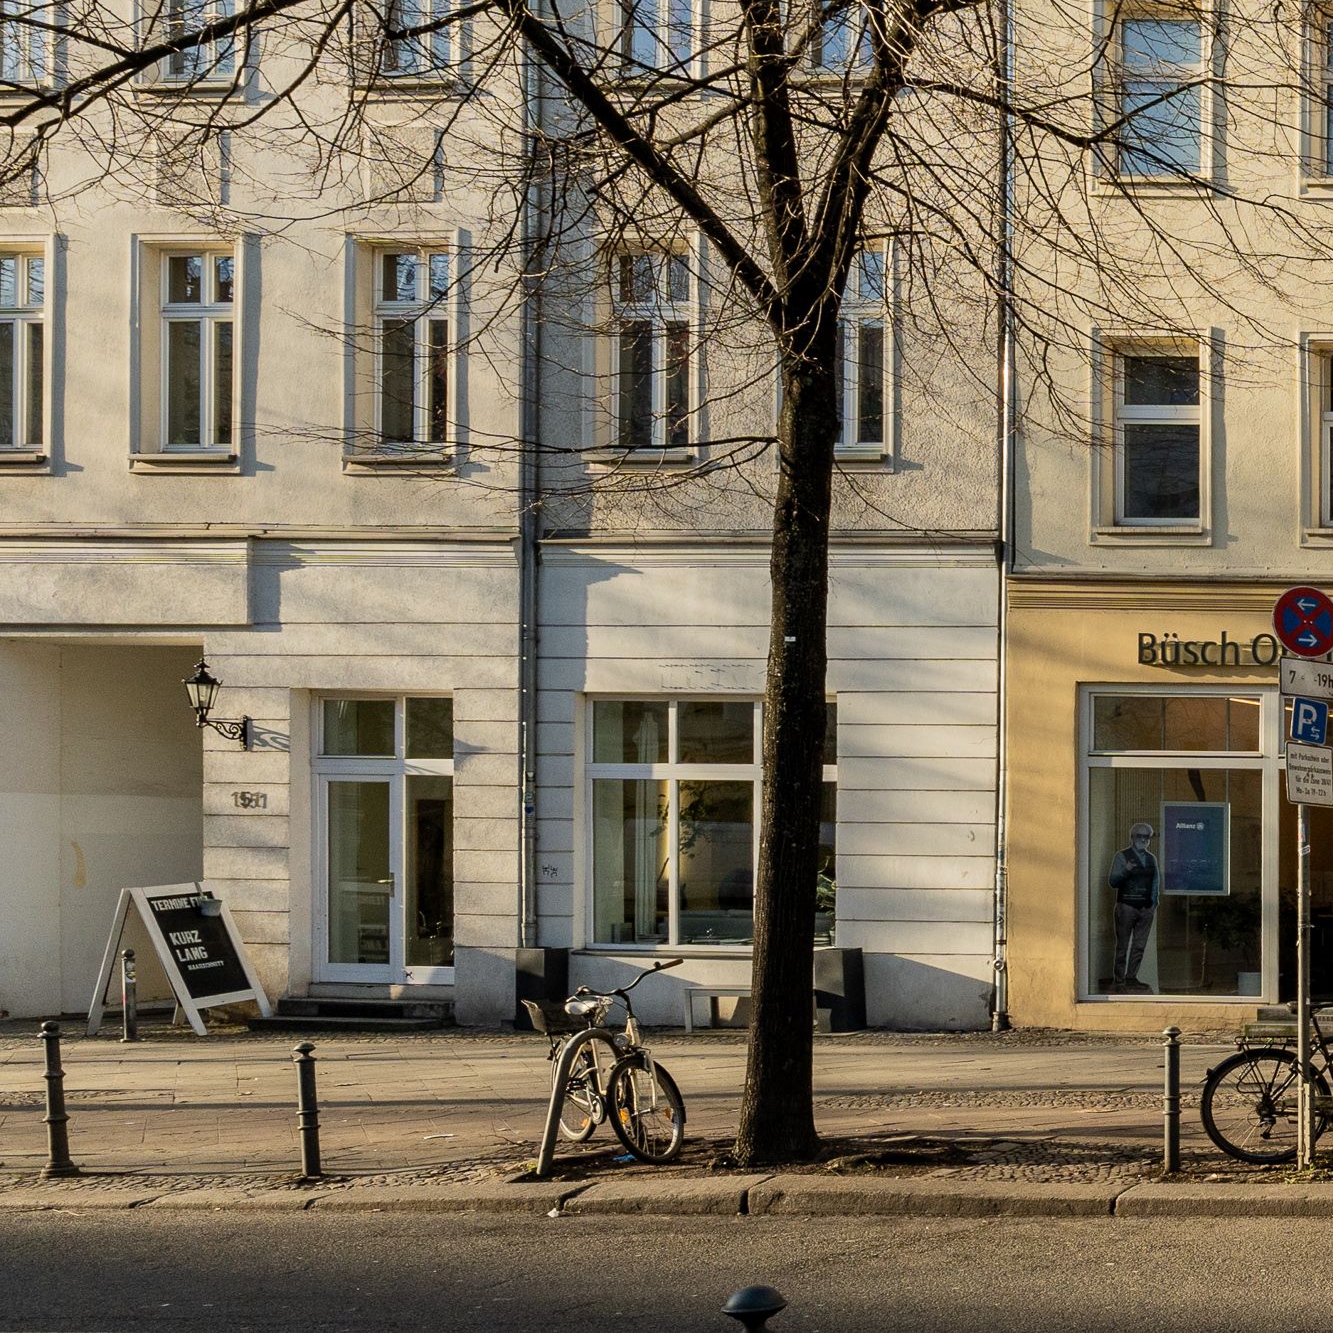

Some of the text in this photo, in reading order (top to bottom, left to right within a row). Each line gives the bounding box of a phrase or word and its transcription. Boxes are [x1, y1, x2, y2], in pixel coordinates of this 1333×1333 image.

[1138, 631, 1240, 666] Büsch
[1288, 670, 1297, 684] 7
[1297, 703, 1318, 735] P
[150, 897, 190, 912] TERMINE
[169, 930, 202, 946] KURZ
[176, 946, 209, 962] LANG
